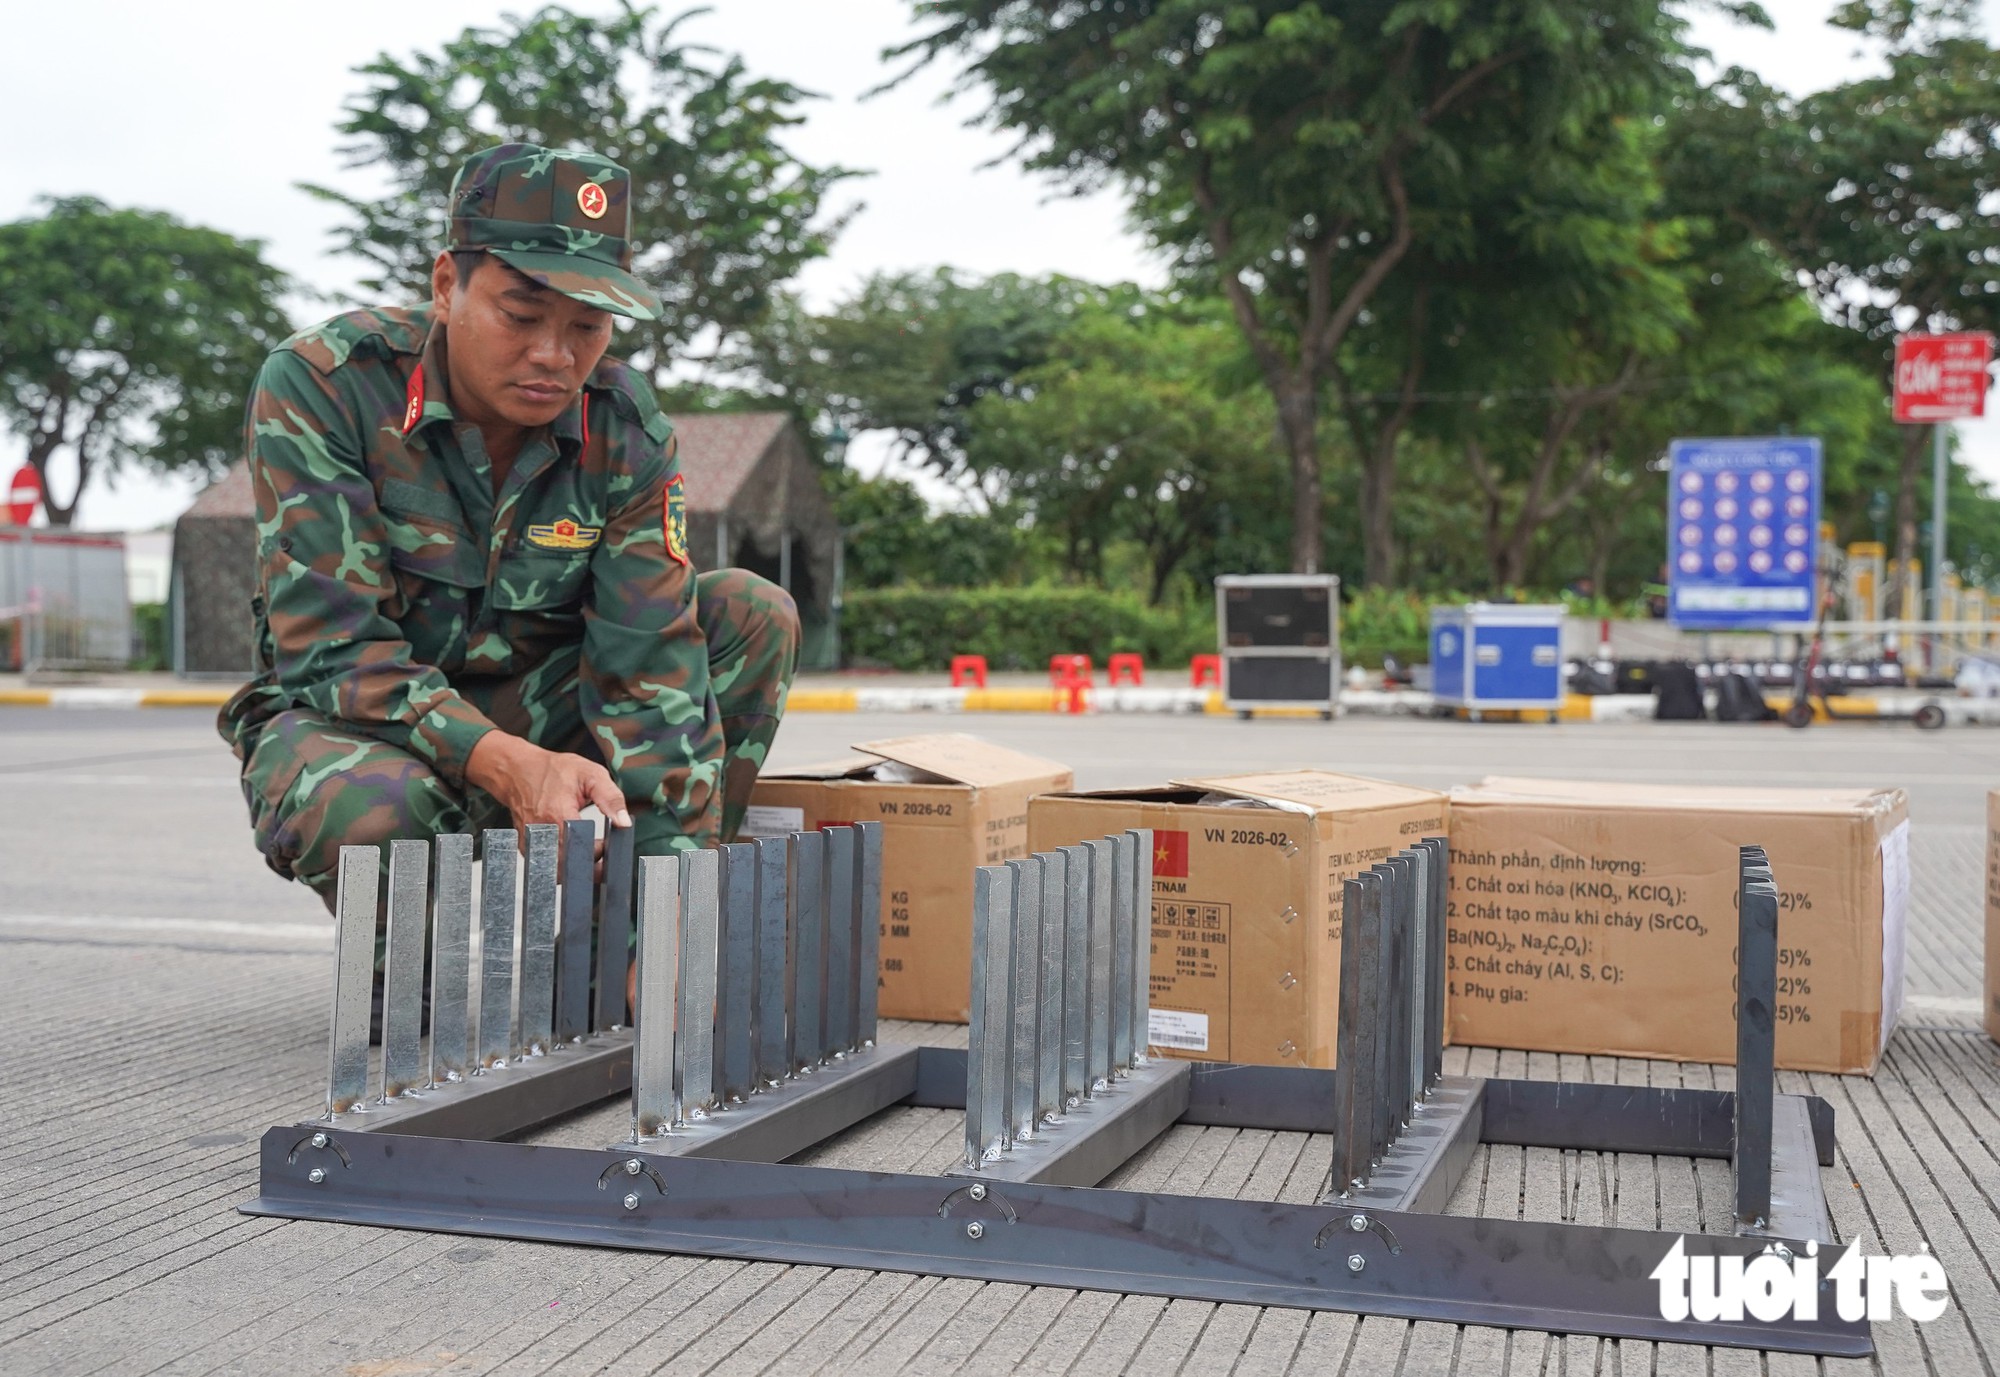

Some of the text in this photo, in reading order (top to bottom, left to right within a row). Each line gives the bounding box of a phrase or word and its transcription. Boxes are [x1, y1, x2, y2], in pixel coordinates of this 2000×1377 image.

[880, 803, 952, 816] VN 2026-02
[1205, 828, 1287, 846] VN 2026-02
[1449, 849, 1646, 877] Thành phần, định lượng:
[1152, 881, 1187, 893] ETNAM
[1448, 876, 1461, 891] 1.
[1466, 875, 1502, 893] Chất
[1506, 880, 1530, 894] oxi
[1535, 881, 1565, 897] hóa
[891, 891, 908, 904] KG
[892, 908, 908, 921] KG
[1448, 902, 1461, 917] 2.
[1465, 901, 1501, 920] Chất
[1506, 906, 1531, 924] tạo
[1535, 908, 1569, 924] màu
[1575, 910, 1599, 925] khi
[1604, 911, 1643, 932] cháy
[891, 925, 910, 938] MM
[1465, 955, 1501, 973] Chất
[1505, 959, 1543, 979] cháy
[1548, 962, 1575, 980] (Al,
[1580, 964, 1595, 982] S,
[1601, 965, 1624, 984] C):
[1464, 982, 1495, 1002] Phụ
[1500, 987, 1529, 1003] gia:
